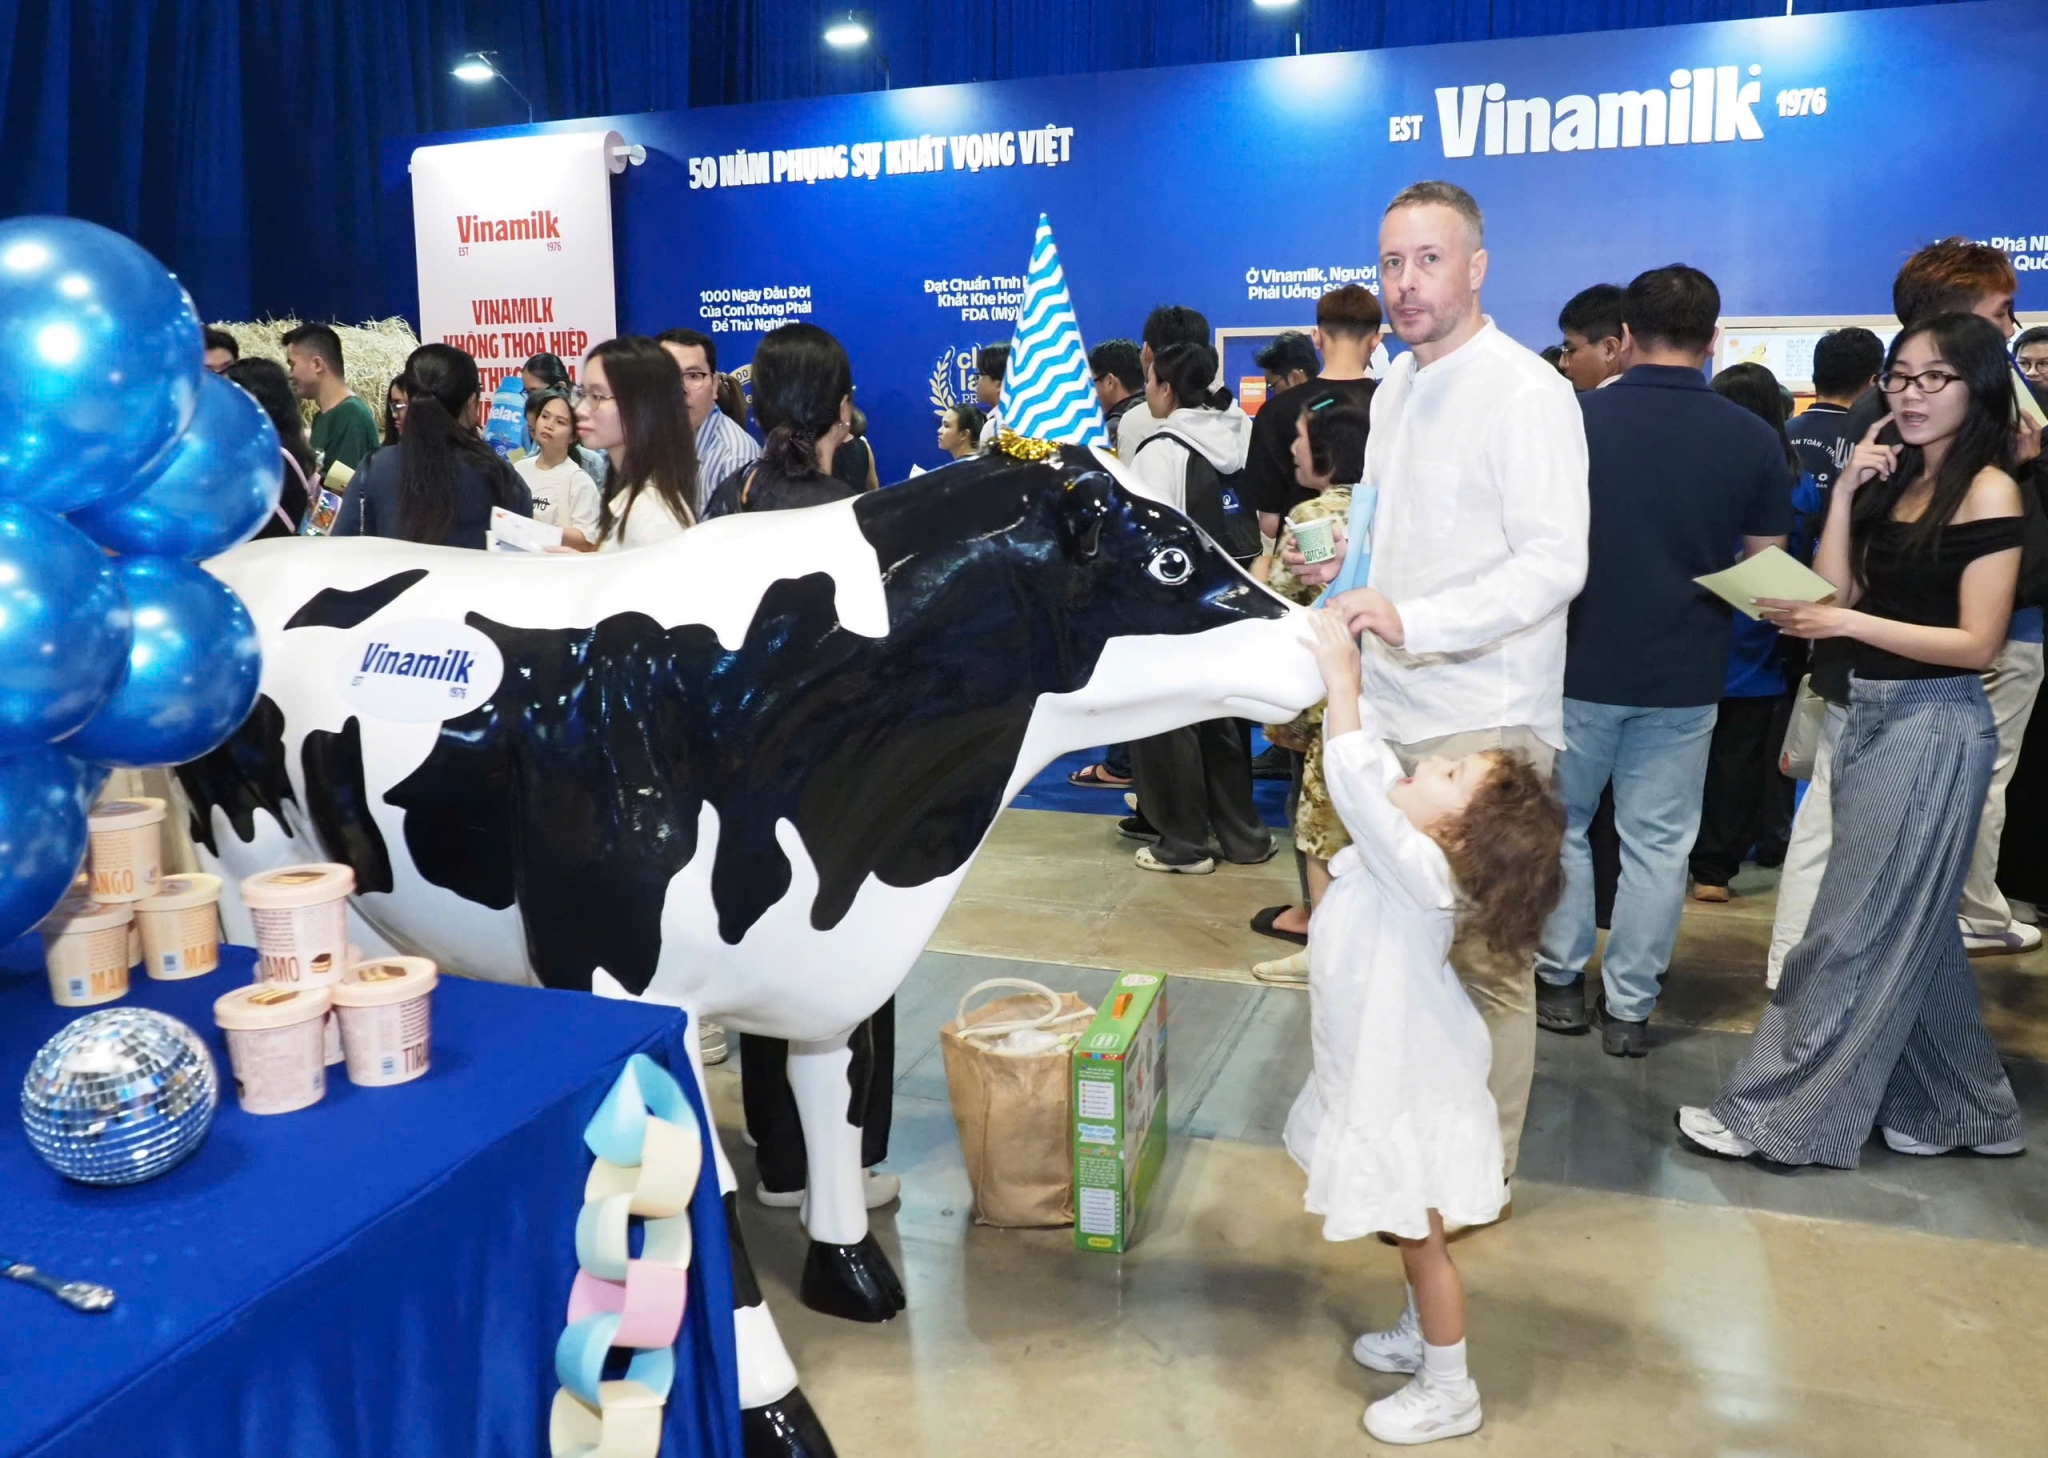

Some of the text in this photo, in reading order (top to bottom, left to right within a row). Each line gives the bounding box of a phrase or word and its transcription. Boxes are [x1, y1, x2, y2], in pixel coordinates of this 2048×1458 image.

[1389, 65, 1827, 158] EST Vinamilk 1976
[689, 123, 1074, 189] 50 NĂM PHỤNG SỰ KHÁT VỌNG VIỆT
[457, 210, 560, 243] Vinamilk
[459, 247, 469, 256] EST
[547, 242, 561, 251] 1976
[1245, 265, 1377, 284] Ở Vinamilk, Người
[924, 279, 949, 294] Đạt
[992, 275, 1020, 290] Tinh
[1248, 285, 1280, 300] Phải
[700, 290, 731, 303] 1000
[970, 293, 996, 306] Khe
[472, 297, 554, 325] VINAMILK
[700, 300, 812, 318] Của Con Không Phải
[961, 308, 989, 321] FDA
[502, 327, 546, 358] THOẢ
[550, 327, 588, 359] HIỆP
[360, 642, 474, 684] Vinamilk
[90, 869, 135, 894] ANGO
